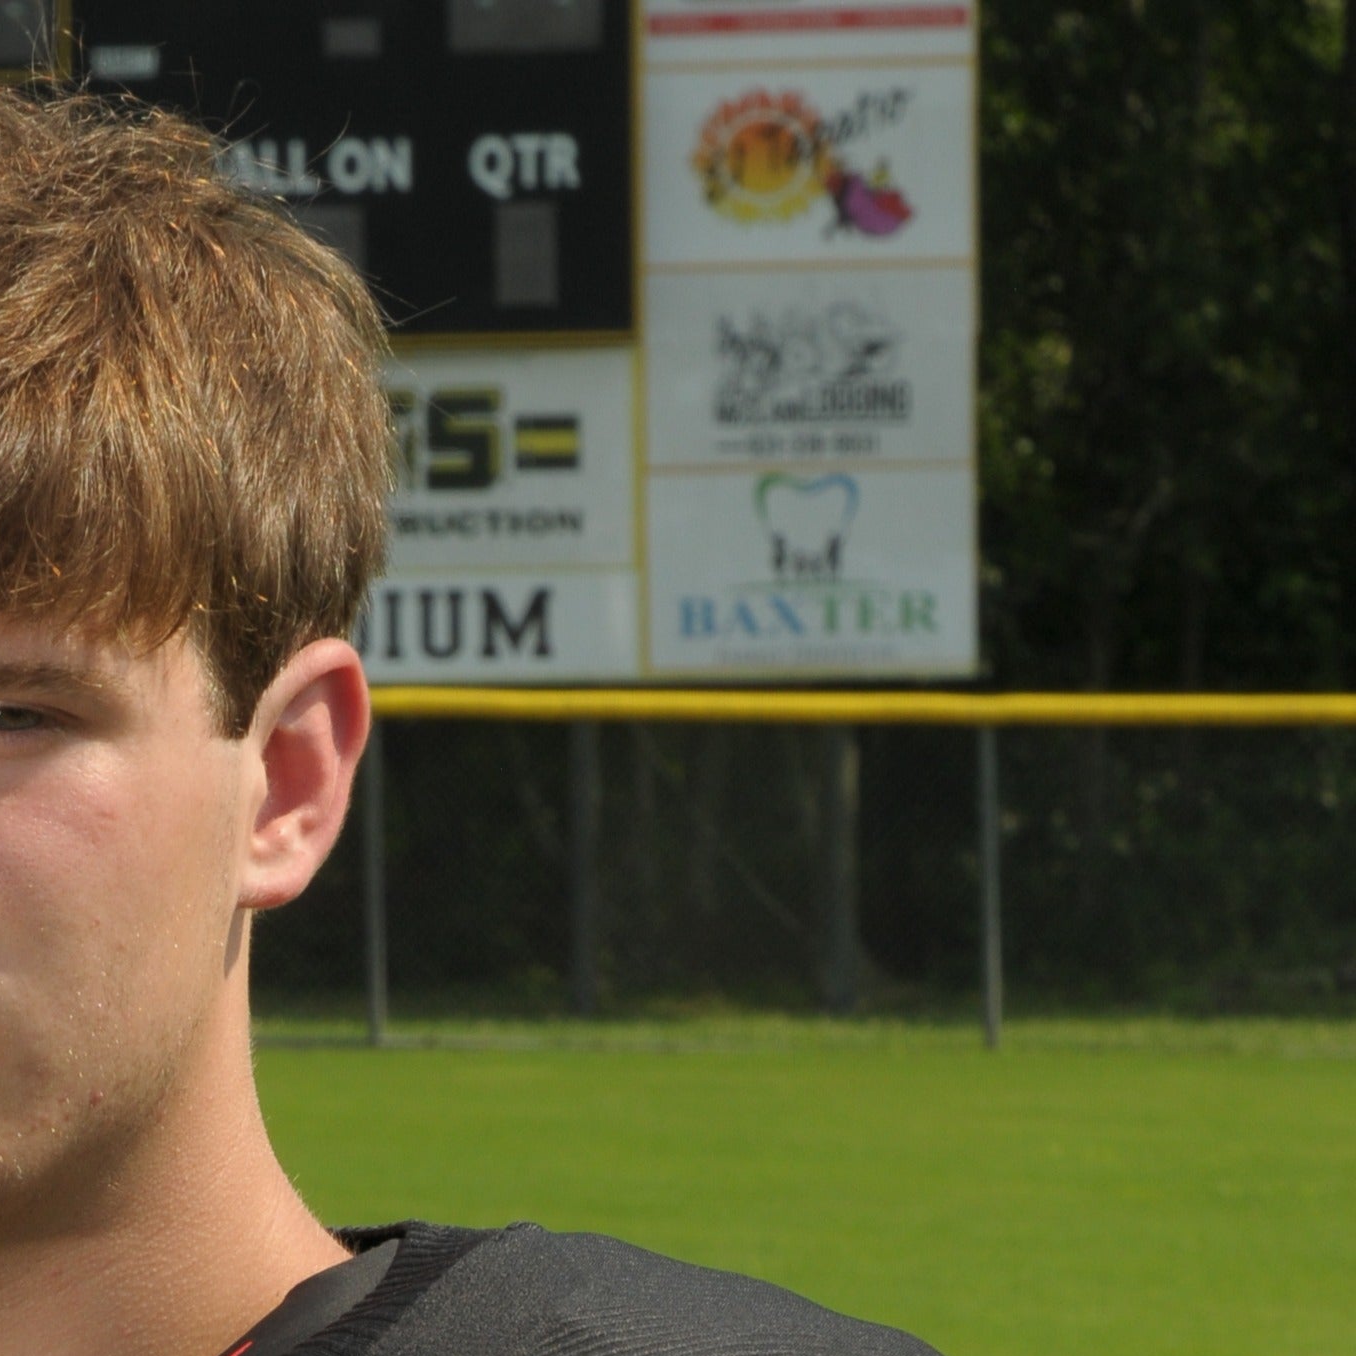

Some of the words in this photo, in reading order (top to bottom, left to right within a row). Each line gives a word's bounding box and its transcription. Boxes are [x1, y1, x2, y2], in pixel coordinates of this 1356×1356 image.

[328, 136, 413, 195] ON
[468, 132, 580, 200] QTR
[358, 585, 558, 660] IUM
[678, 589, 940, 638] BAXTER
